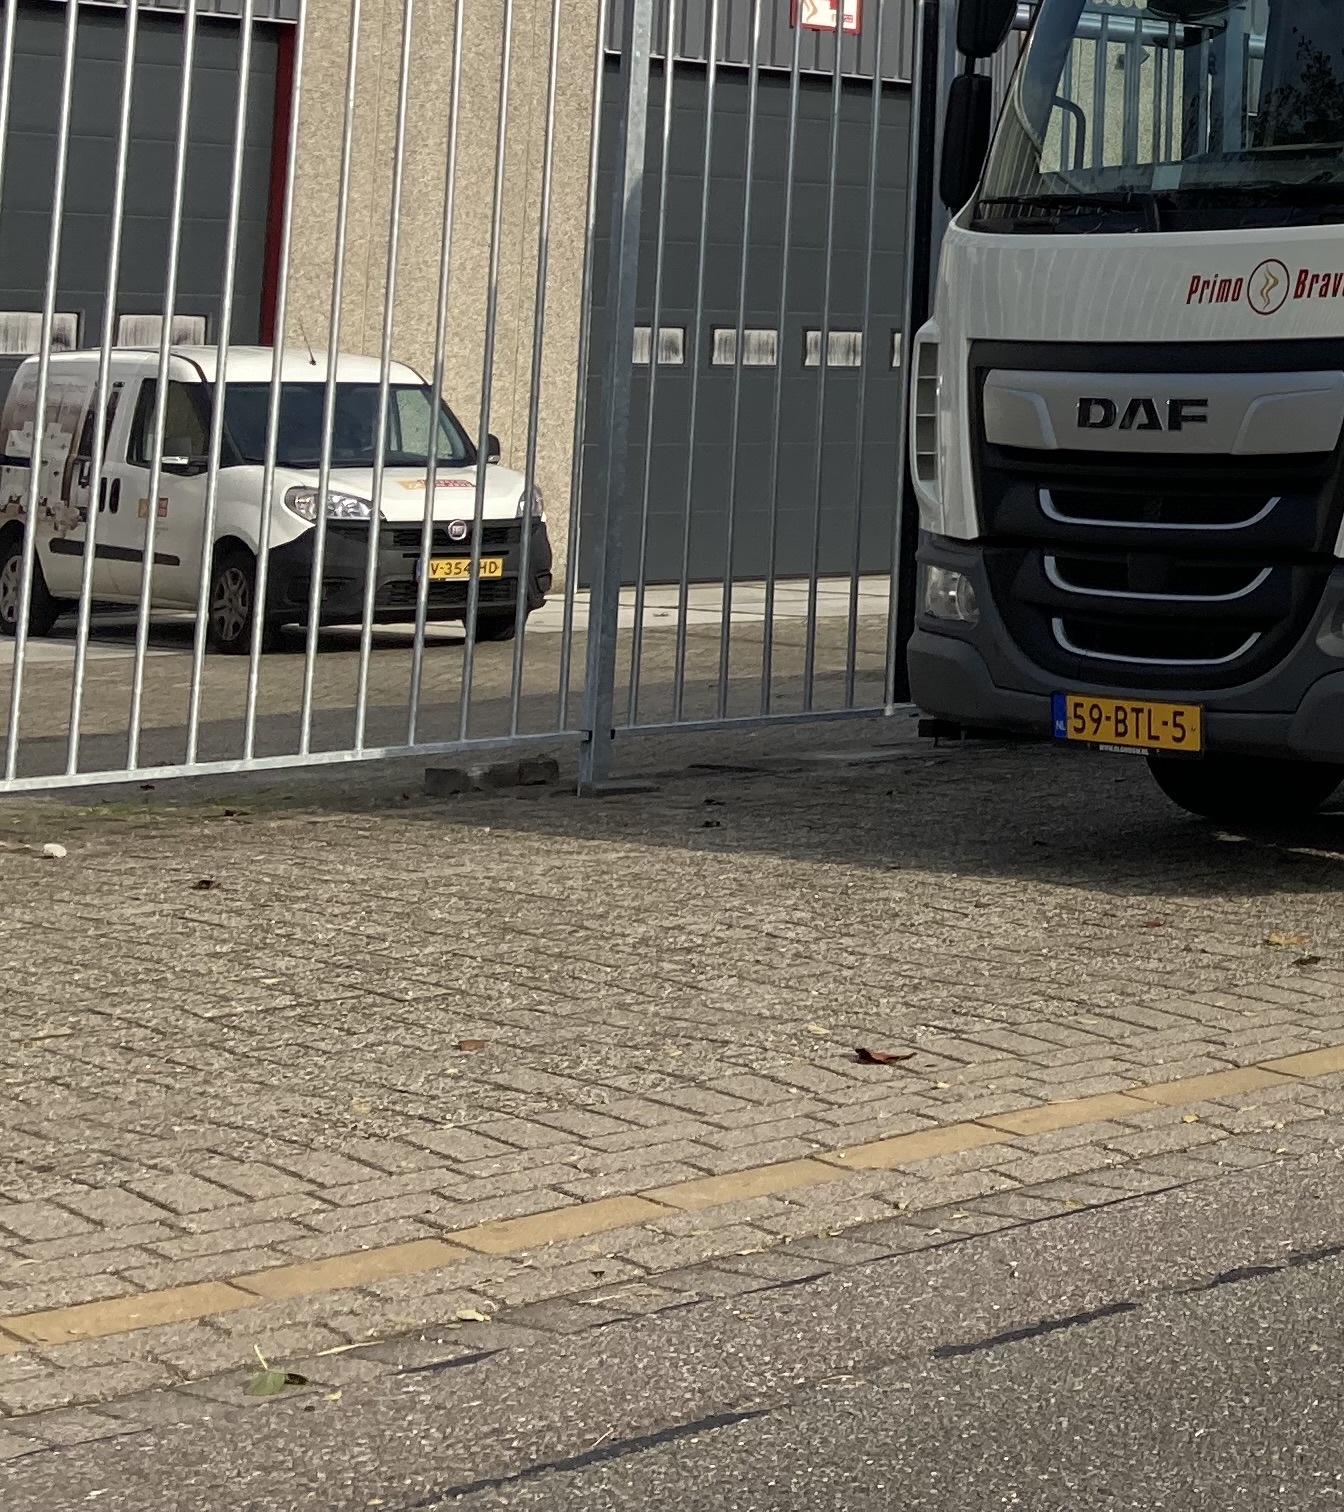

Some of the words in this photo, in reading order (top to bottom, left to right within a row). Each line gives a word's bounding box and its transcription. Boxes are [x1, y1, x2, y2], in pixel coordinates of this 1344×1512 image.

[1186, 273, 1244, 304] Primo
[1077, 397, 1209, 431] DAF
[1055, 719, 1067, 731] NL
[1073, 701, 1187, 744] 59-BTL-5
